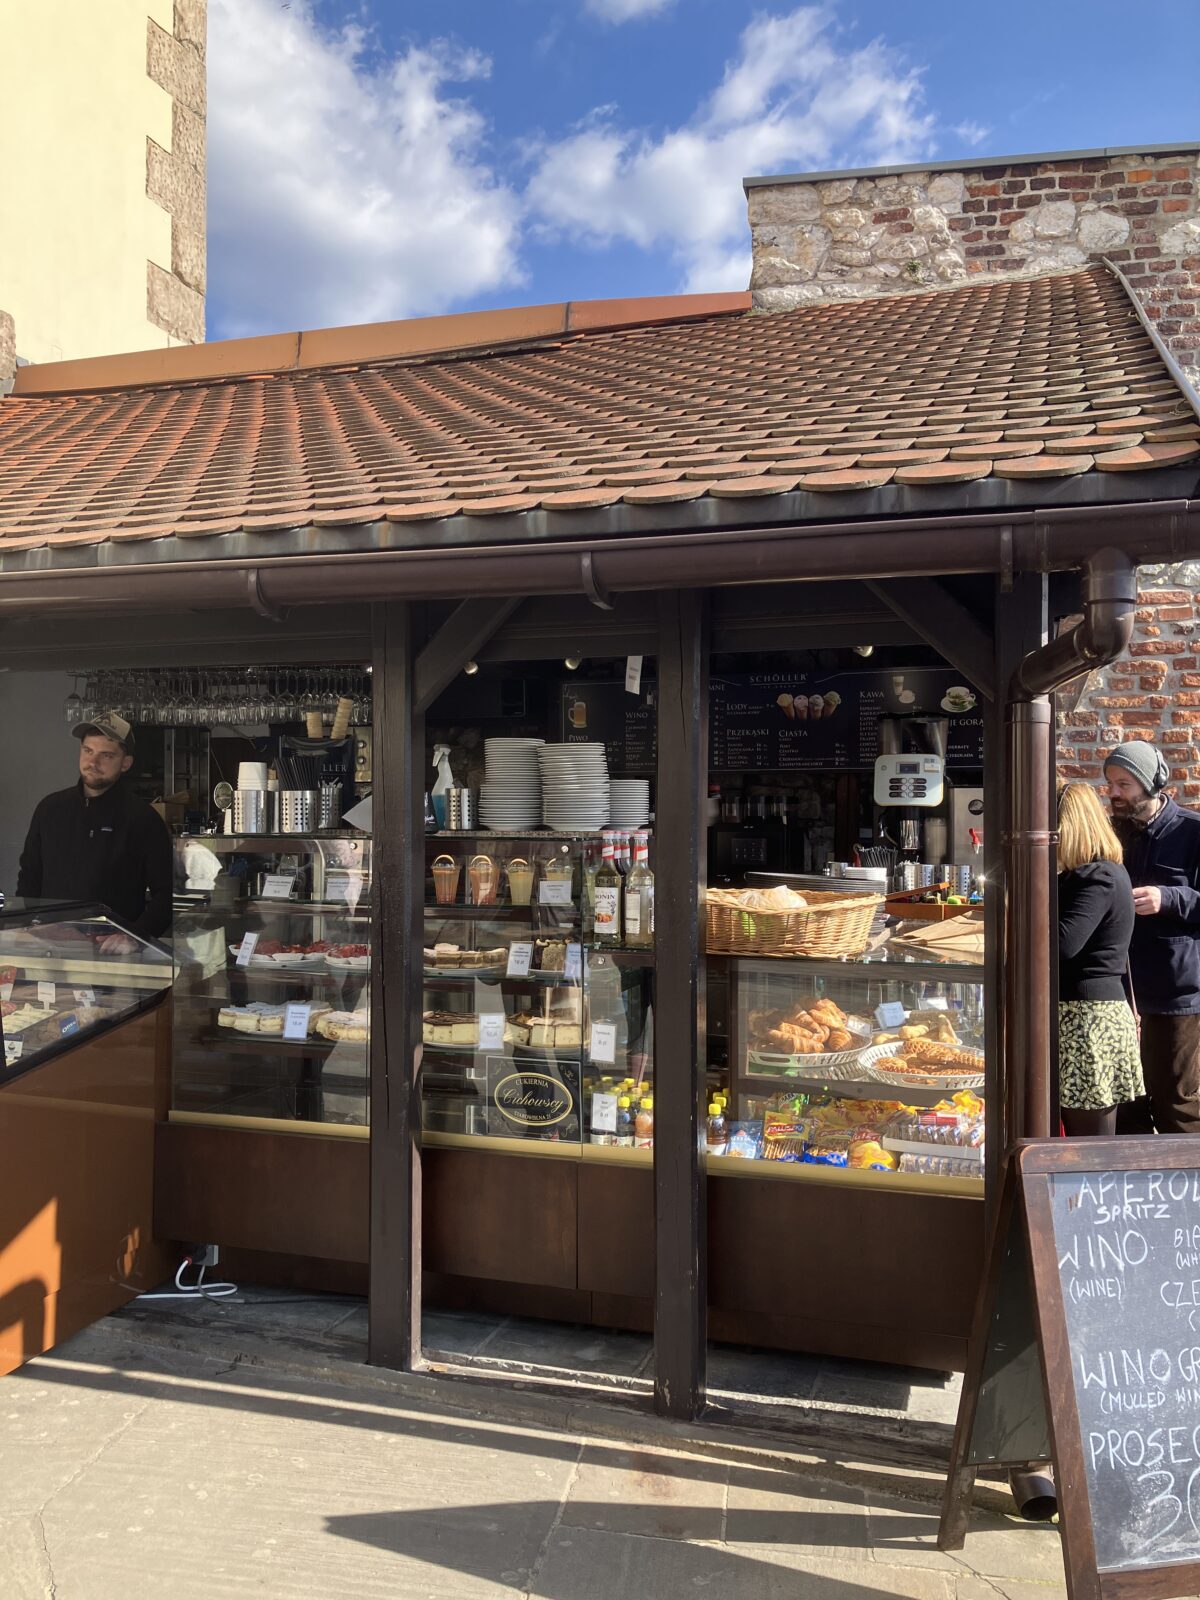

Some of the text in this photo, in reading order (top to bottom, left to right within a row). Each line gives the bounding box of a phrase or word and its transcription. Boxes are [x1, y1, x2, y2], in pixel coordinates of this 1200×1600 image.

[750, 674, 807, 683] SCHÖLLER
[727, 729, 769, 737] PRZEKĄSKI
[515, 1078, 550, 1090] CUKIERNIA
[503, 1087, 564, 1114] Cichowscy
[1093, 1203, 1172, 1225] SPRITZ
[1069, 1277, 1122, 1304] (WINE)
[1079, 1347, 1172, 1389] WINO
[1100, 1390, 1166, 1415] (MULLED
